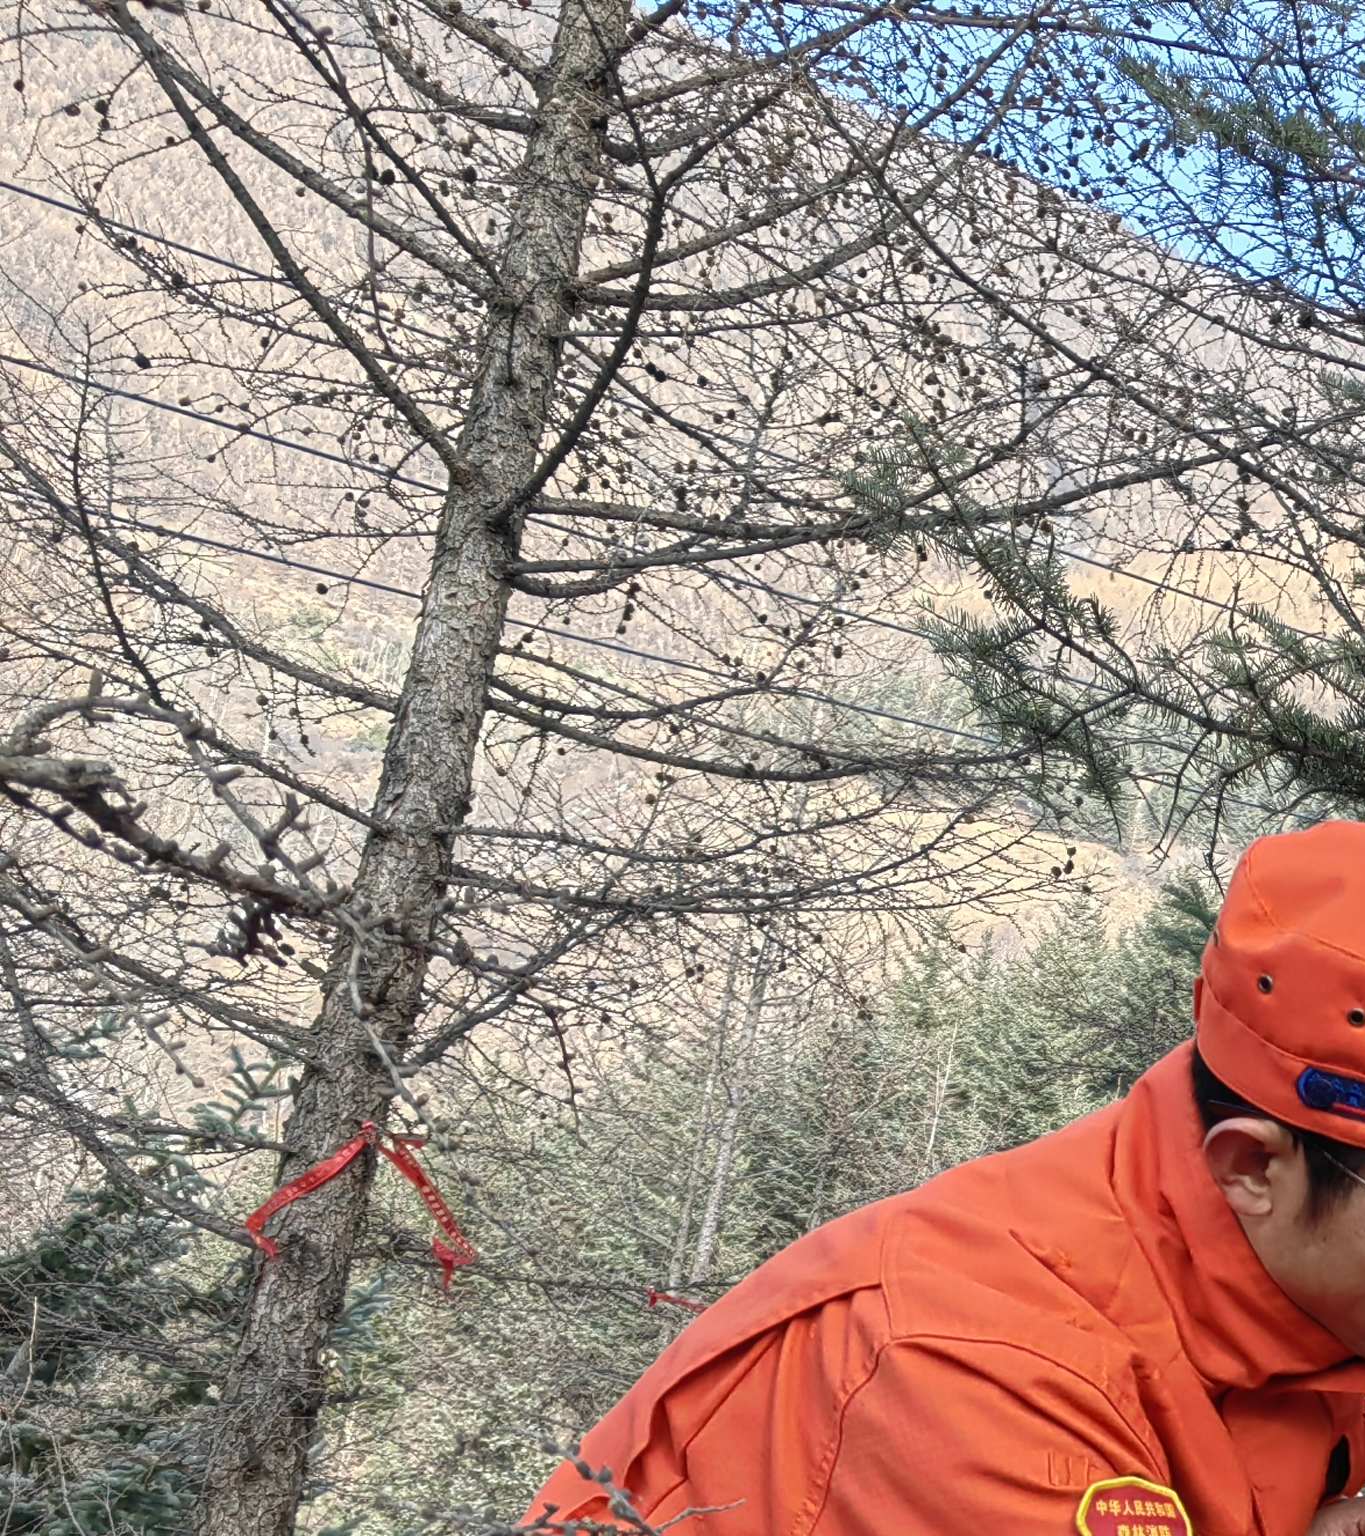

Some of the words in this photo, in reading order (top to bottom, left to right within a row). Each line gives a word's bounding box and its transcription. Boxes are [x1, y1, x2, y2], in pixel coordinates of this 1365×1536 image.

[1095, 1499, 1177, 1519] 中华人民共和国
